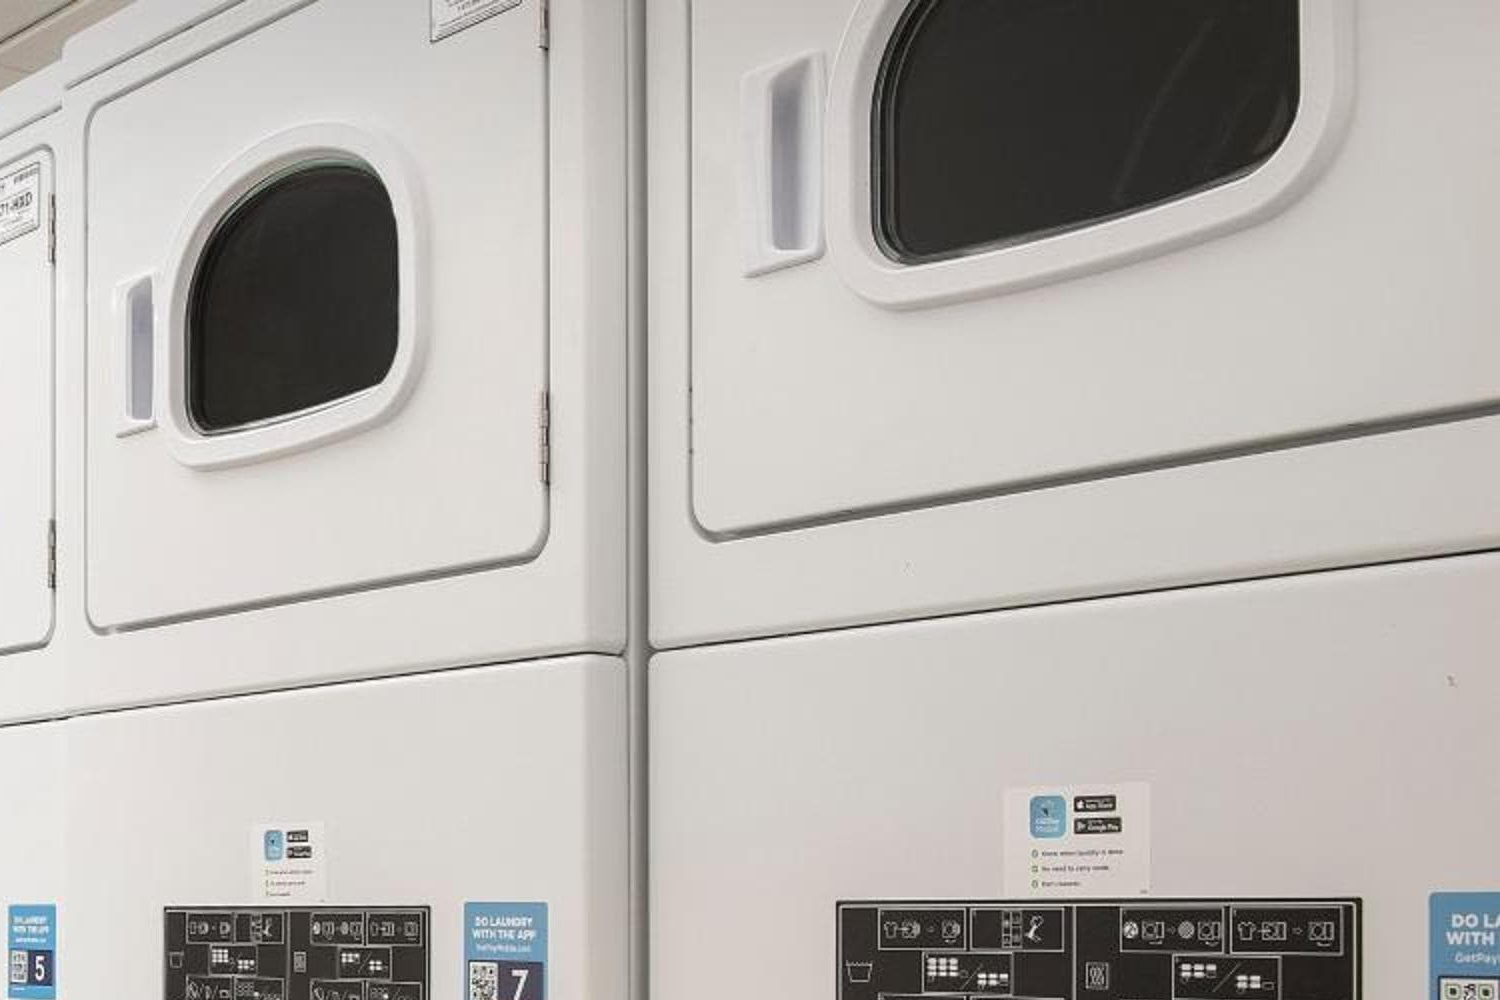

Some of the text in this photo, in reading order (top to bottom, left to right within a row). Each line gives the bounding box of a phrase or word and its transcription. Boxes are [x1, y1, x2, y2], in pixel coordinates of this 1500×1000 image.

[1452, 913, 1478, 928] DO
[1446, 931, 1495, 945] WITH
[35, 955, 45, 982] 5
